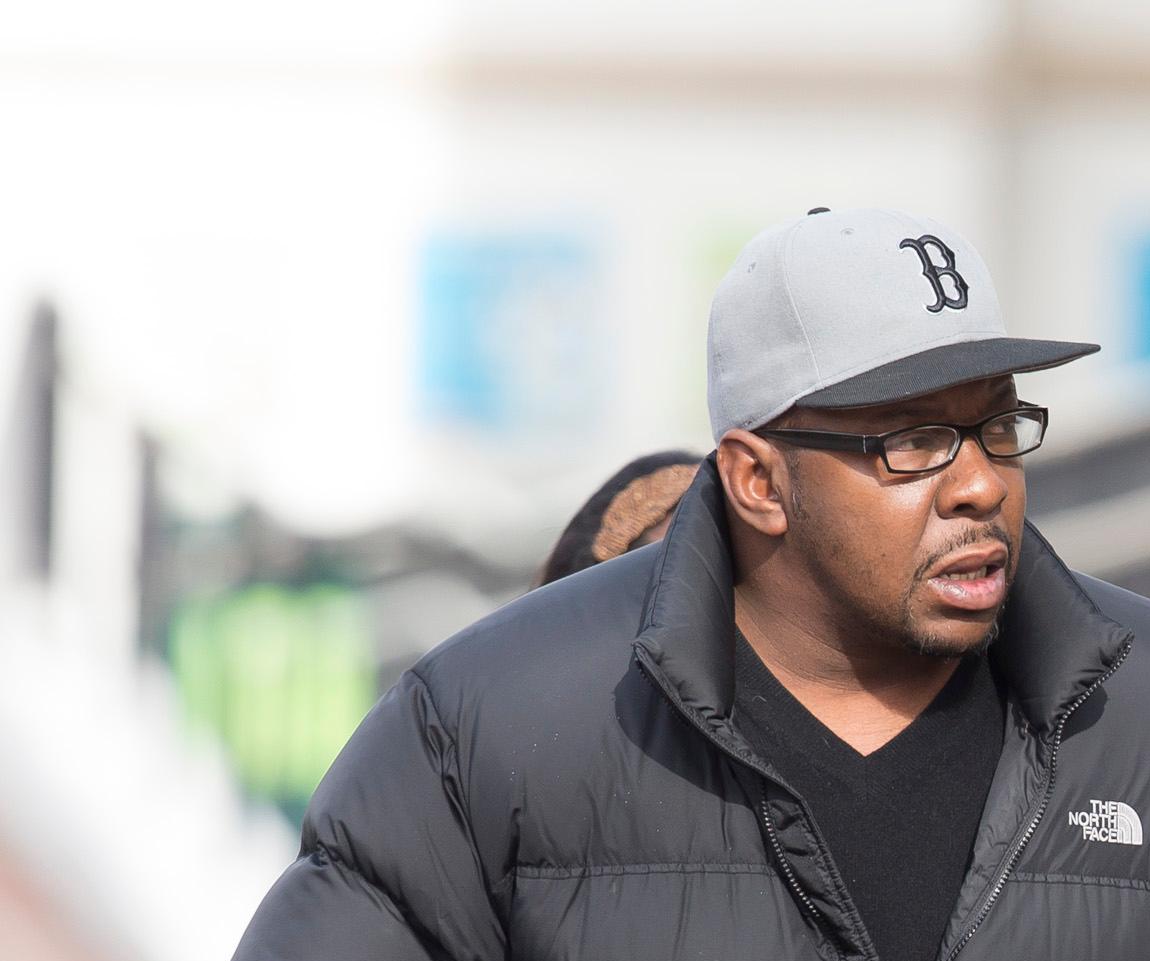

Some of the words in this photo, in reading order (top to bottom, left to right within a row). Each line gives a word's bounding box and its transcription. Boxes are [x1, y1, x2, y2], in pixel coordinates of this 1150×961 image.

[899, 234, 969, 313] B
[1089, 799, 1118, 816] THE
[1068, 811, 1118, 829] NORTH
[1082, 826, 1118, 843] FACE
